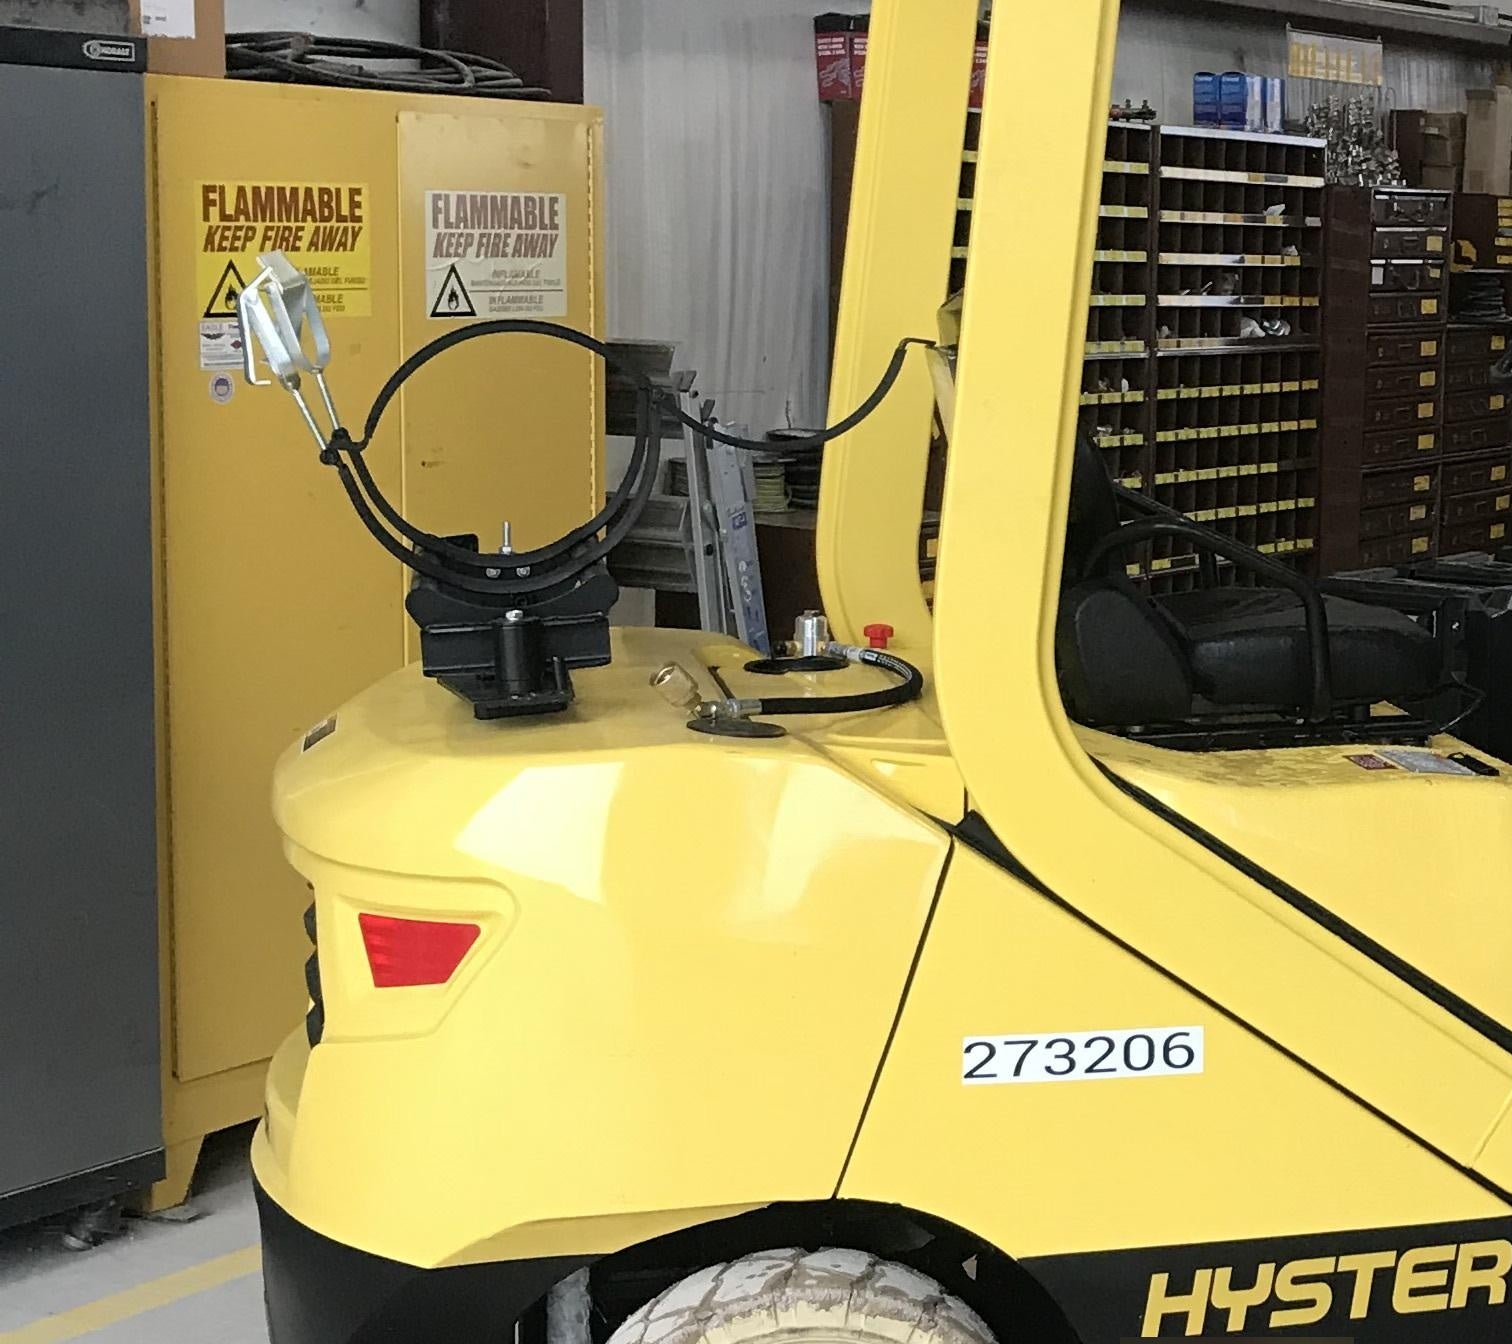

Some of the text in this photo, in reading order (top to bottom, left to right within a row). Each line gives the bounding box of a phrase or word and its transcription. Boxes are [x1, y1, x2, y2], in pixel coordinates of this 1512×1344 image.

[202, 184, 363, 223] FLAMMABLE
[432, 193, 559, 230] FLAMMABLE
[203, 225, 363, 252] KEEP FIRE AWAY
[433, 232, 559, 258] KEEP FIRE AWAY
[963, 1032, 1195, 1078] 273206
